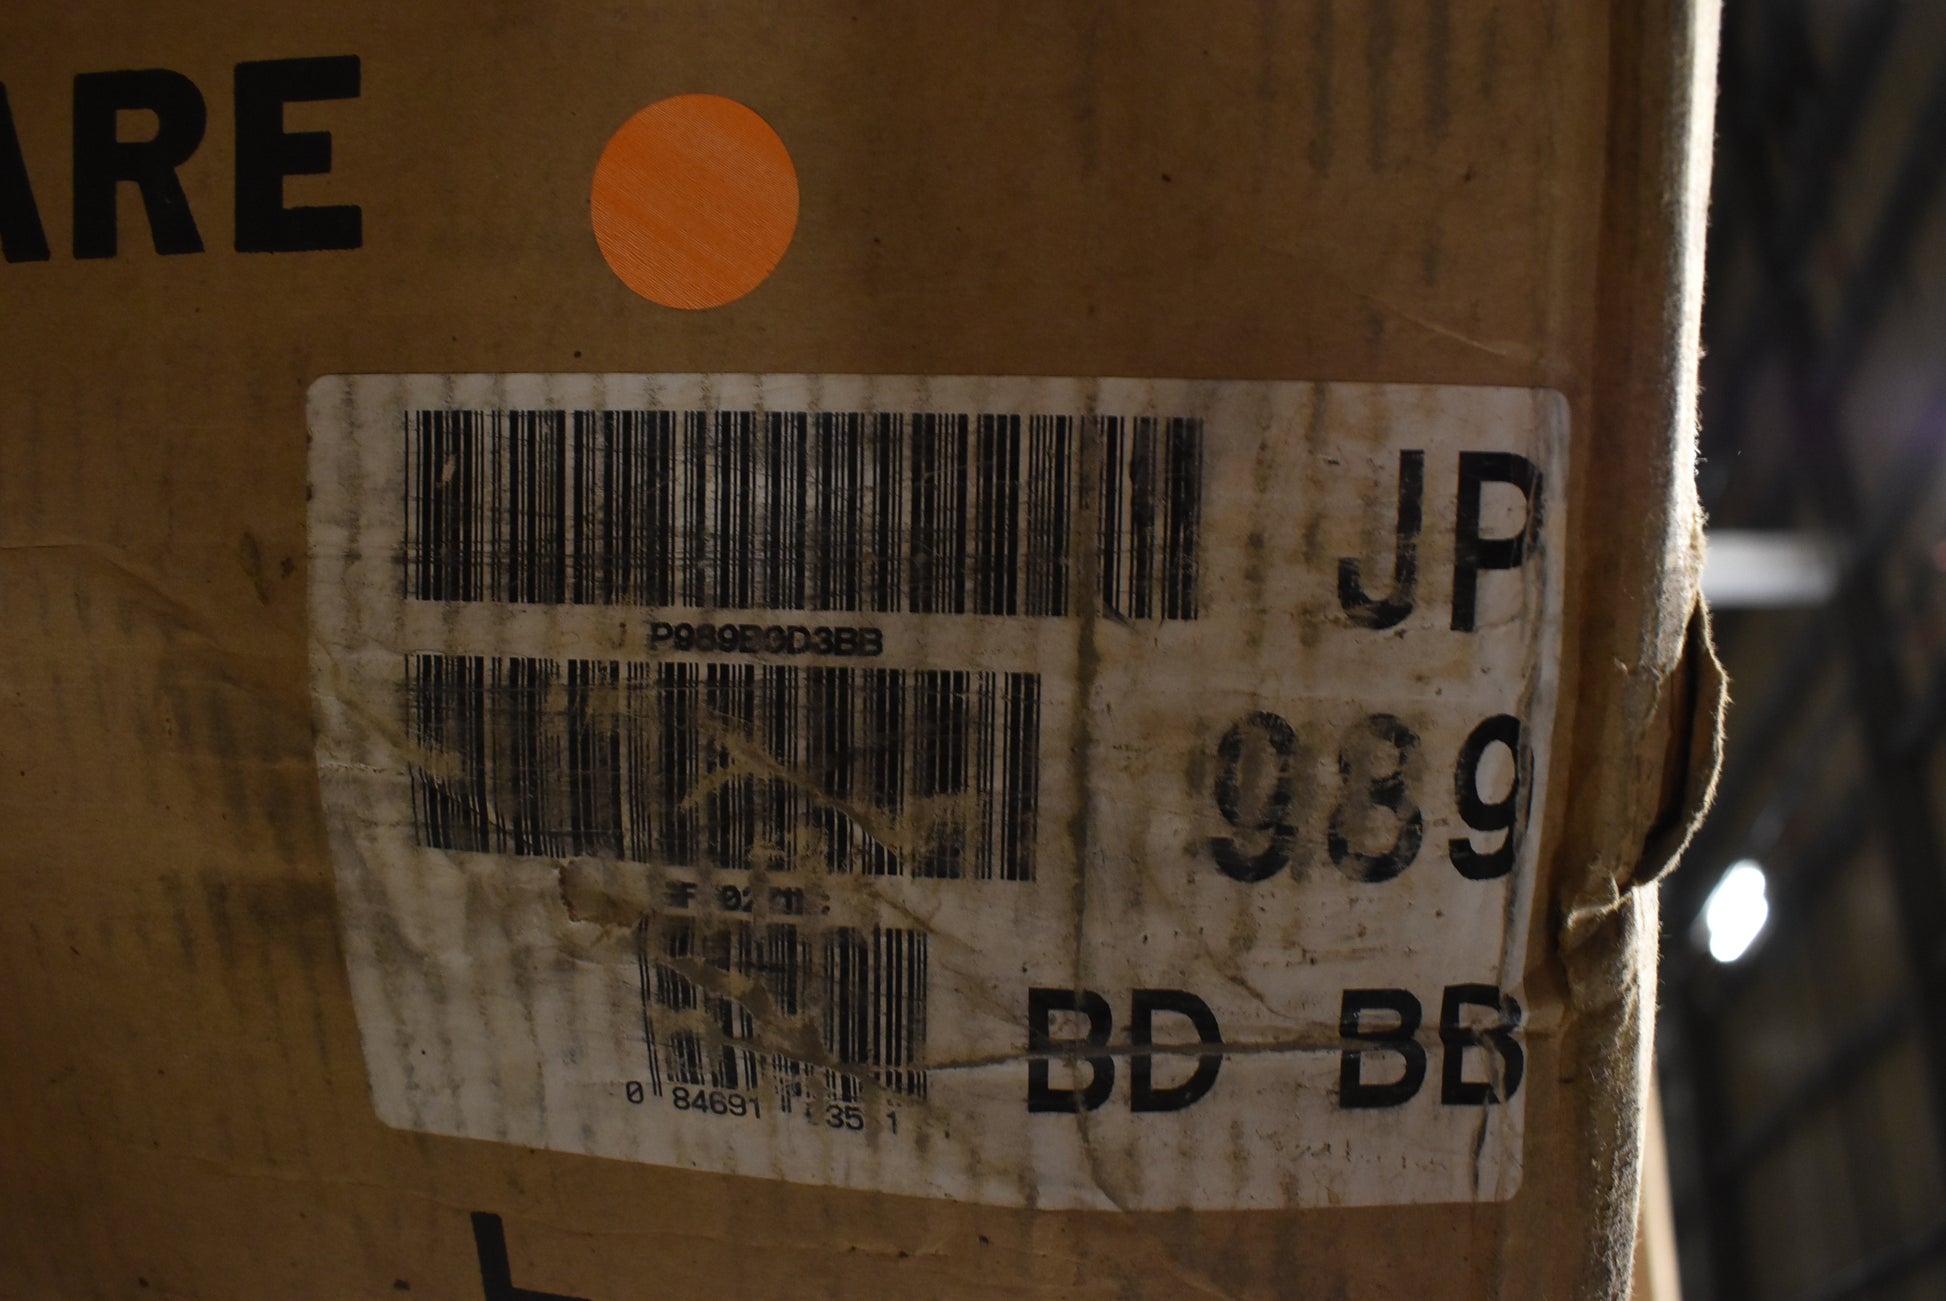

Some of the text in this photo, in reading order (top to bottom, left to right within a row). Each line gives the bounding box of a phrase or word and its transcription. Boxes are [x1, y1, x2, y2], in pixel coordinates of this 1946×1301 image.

[1338, 449, 1544, 632] JP
[1208, 711, 1534, 884] 989
[672, 1086, 761, 1119] 84691
[1028, 983, 1524, 1113] BD BB
